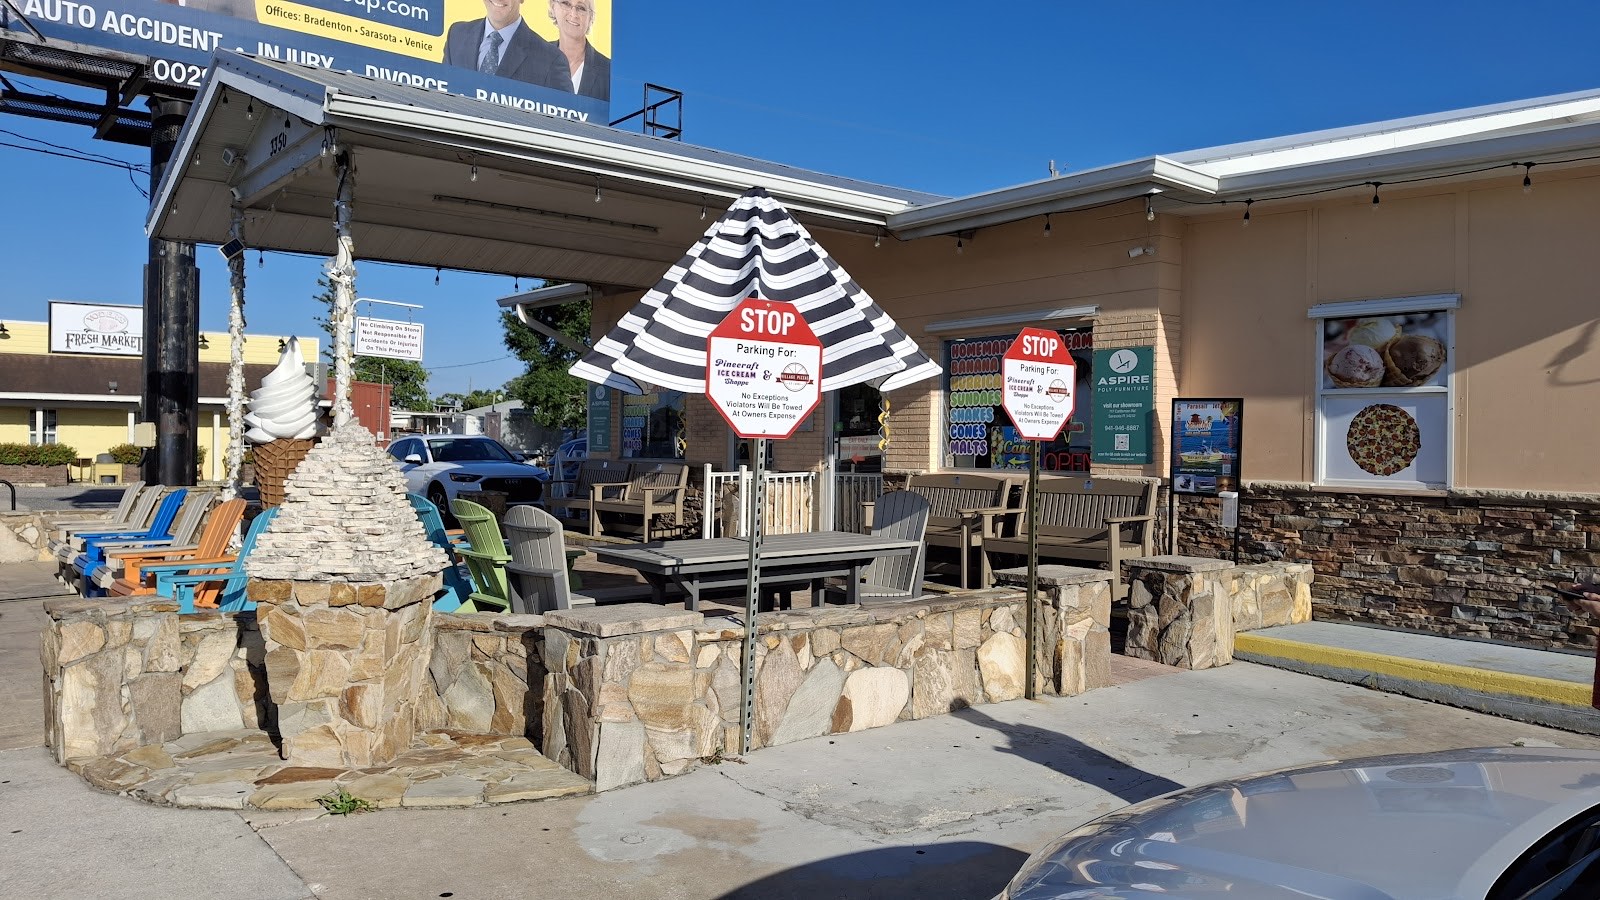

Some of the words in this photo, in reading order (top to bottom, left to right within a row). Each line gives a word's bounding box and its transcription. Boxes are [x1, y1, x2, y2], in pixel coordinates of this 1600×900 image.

[343, 0, 429, 21] p.com
[24, 0, 96, 28] AUTO
[102, 10, 222, 52] ACCIDENT
[265, 5, 301, 22] Offices:
[304, 14, 352, 32] Bradenton
[360, 27, 397, 44] Sarasota
[404, 36, 432, 52] Venice
[153, 59, 207, 87] 002
[370, 322, 394, 330] Climbing
[740, 307, 796, 336] STOP
[66, 332, 98, 349] FRESH
[102, 333, 143, 352] MARKET
[374, 330, 406, 338] Responsible
[736, 344, 775, 358] Parking
[778, 347, 797, 358] For:
[1022, 335, 1058, 357] STOP
[715, 358, 760, 370] Pinecraft
[951, 357, 999, 375] BANANA
[1020, 364, 1044, 376] Parking
[1046, 366, 1059, 375] For:
[724, 378, 749, 386] Shoppe
[732, 370, 756, 378] CREAM
[950, 373, 1002, 391] HURRICA
[1098, 375, 1150, 386] ASPIRE
[726, 400, 756, 408] Violators
[753, 393, 789, 402] Exceptions
[950, 390, 1002, 407] SUNDAES
[950, 407, 994, 423] SHAKES
[950, 424, 987, 439] CONES
[950, 440, 988, 456] MALTS
